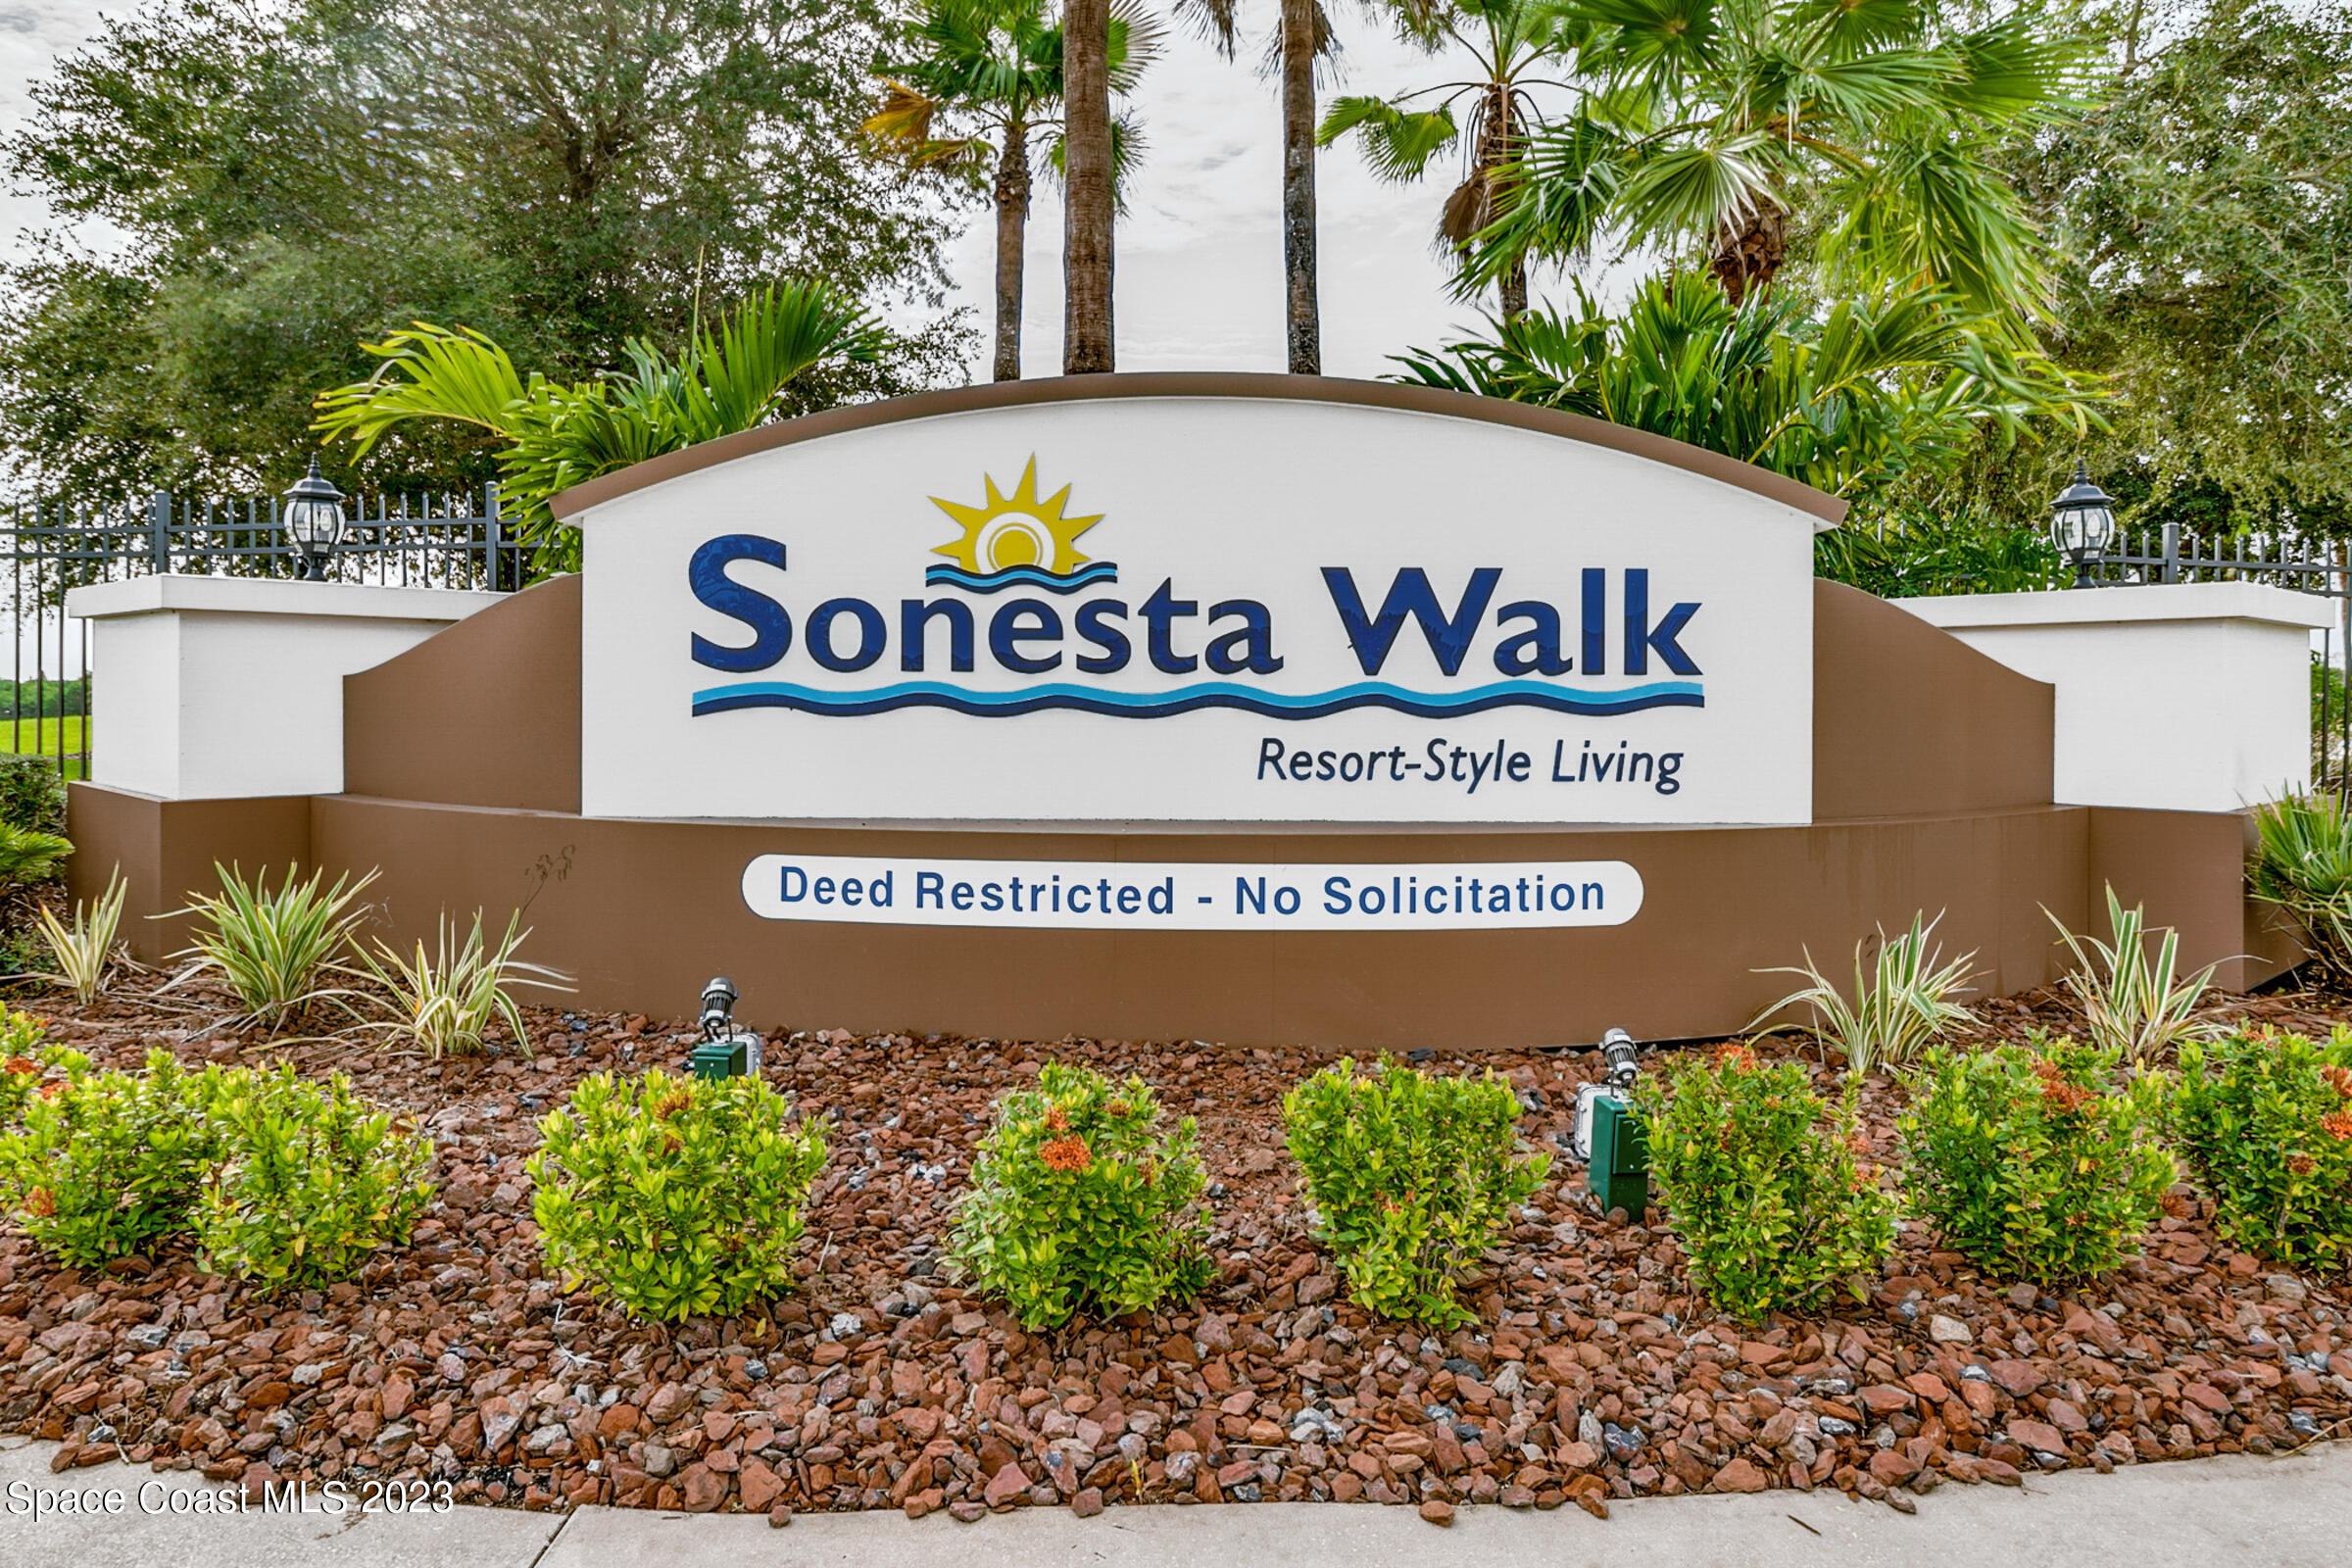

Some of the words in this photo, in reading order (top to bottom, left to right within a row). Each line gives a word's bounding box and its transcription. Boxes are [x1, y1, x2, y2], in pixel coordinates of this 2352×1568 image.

[688, 533, 1285, 676] Sonesta
[1319, 565, 1705, 678] Walk
[1256, 737, 1533, 796] Resort-Style
[1550, 738, 1686, 796] Living
[780, 865, 895, 907] Deed
[915, 871, 1175, 916] Restricted
[1235, 875, 1302, 916] No
[1322, 874, 1605, 916] Solicitation
